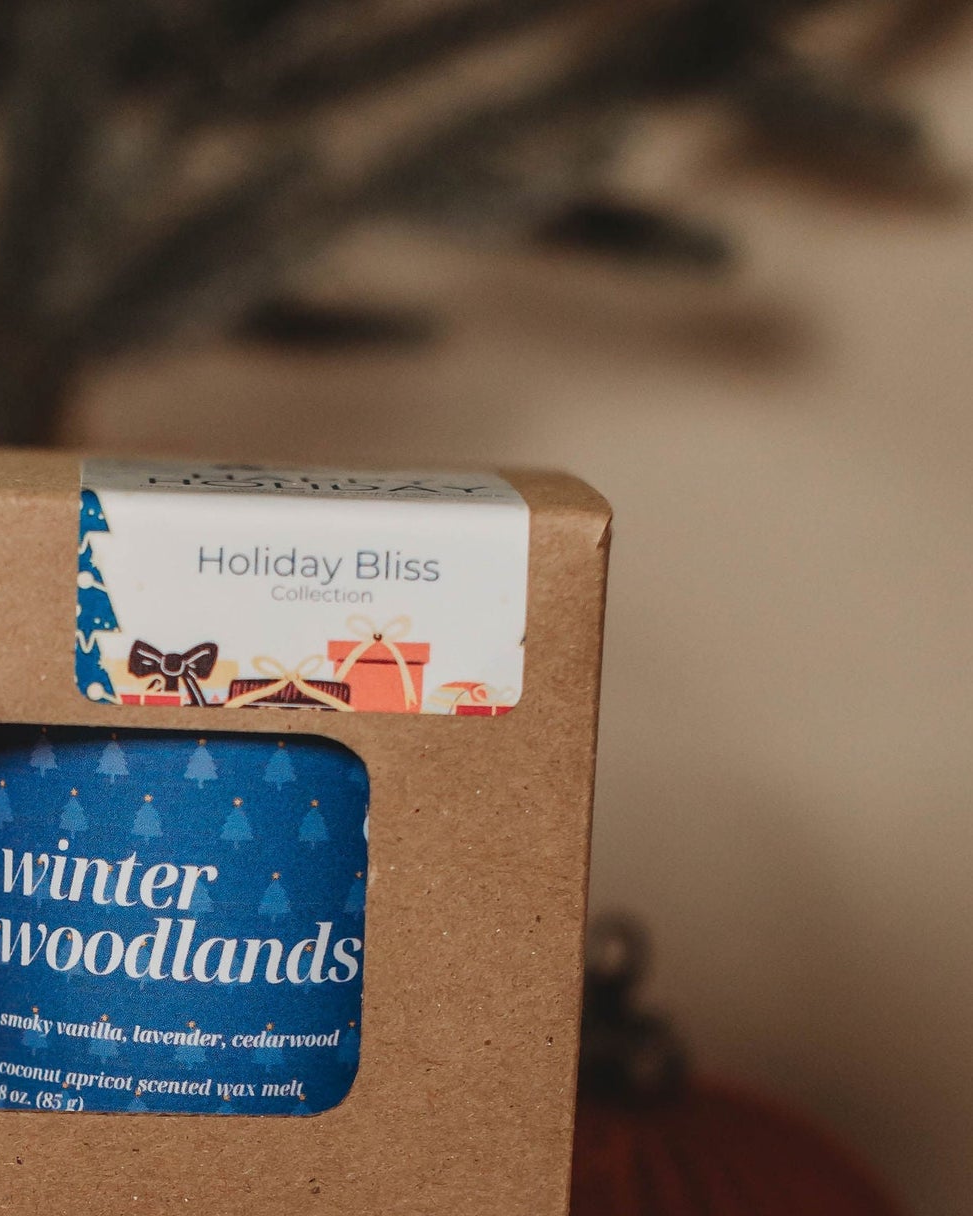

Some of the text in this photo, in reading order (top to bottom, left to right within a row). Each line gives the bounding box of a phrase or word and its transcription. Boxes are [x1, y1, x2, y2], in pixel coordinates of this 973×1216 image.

[197, 546, 441, 585] Holiday Bliss
[270, 585, 374, 604] Collection
[1, 839, 219, 910] winter
[0, 917, 363, 985] woodlands
[0, 1011, 340, 1050] smoky vanilla, lavender, cedarwood
[10, 1088, 31, 1105] oz.
[35, 1089, 63, 1110] (85
[65, 1071, 133, 1092] apricot
[137, 1076, 212, 1097] scented
[217, 1082, 256, 1097] wax
[261, 1080, 303, 1097] melt
